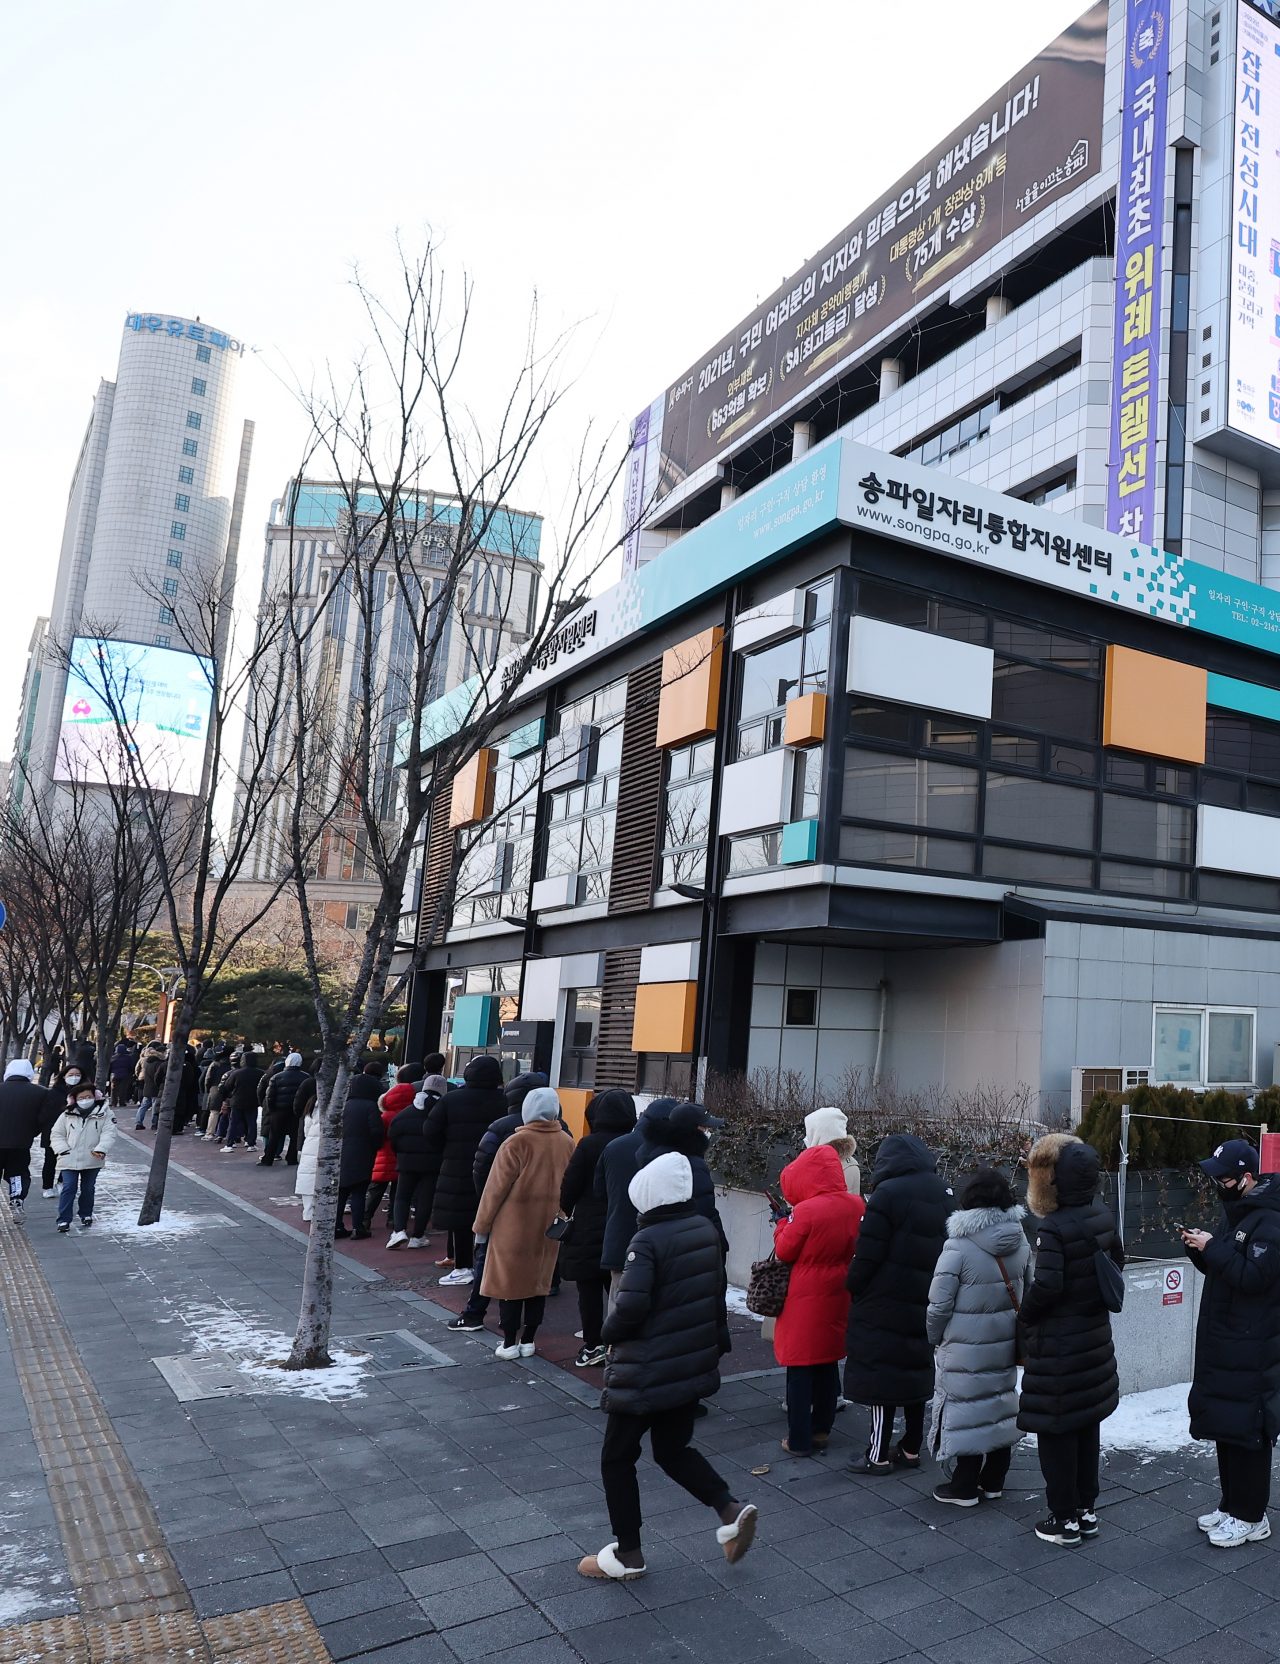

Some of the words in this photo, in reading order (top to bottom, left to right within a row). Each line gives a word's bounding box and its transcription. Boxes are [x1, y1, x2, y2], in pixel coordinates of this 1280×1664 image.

[1241, 46, 1263, 117] 잡지
[1127, 75, 1157, 245] 국내최초
[1238, 120, 1261, 258] 전성시대
[698, 345, 736, 395] 2021년,
[739, 319, 764, 357] 구민
[765, 272, 817, 337] 여러분의
[820, 230, 863, 291] 지지와
[866, 171, 932, 250] 믿음으로
[935, 74, 1040, 191] 해냈습니다!
[889, 214, 927, 264] 대통령상
[944, 178, 974, 217] 장관상
[975, 162, 994, 193] 8개
[995, 152, 1008, 178] 등
[913, 225, 942, 273] 75개
[945, 201, 977, 243] 수상
[785, 304, 851, 374] SA(최고등급)
[854, 280, 878, 319] 달성
[795, 308, 819, 340] 지자체
[1123, 244, 1154, 347] 위례
[675, 375, 694, 402] 송파구
[711, 391, 746, 433] 663억원
[748, 373, 767, 402] 확보
[1117, 347, 1151, 499] 트램선
[856, 503, 990, 557] www.songpa.go.kr
[857, 471, 1113, 576] 송파일자리통합지원센터
[1208, 588, 1231, 606] 일자리
[1231, 610, 1249, 624] TEL:
